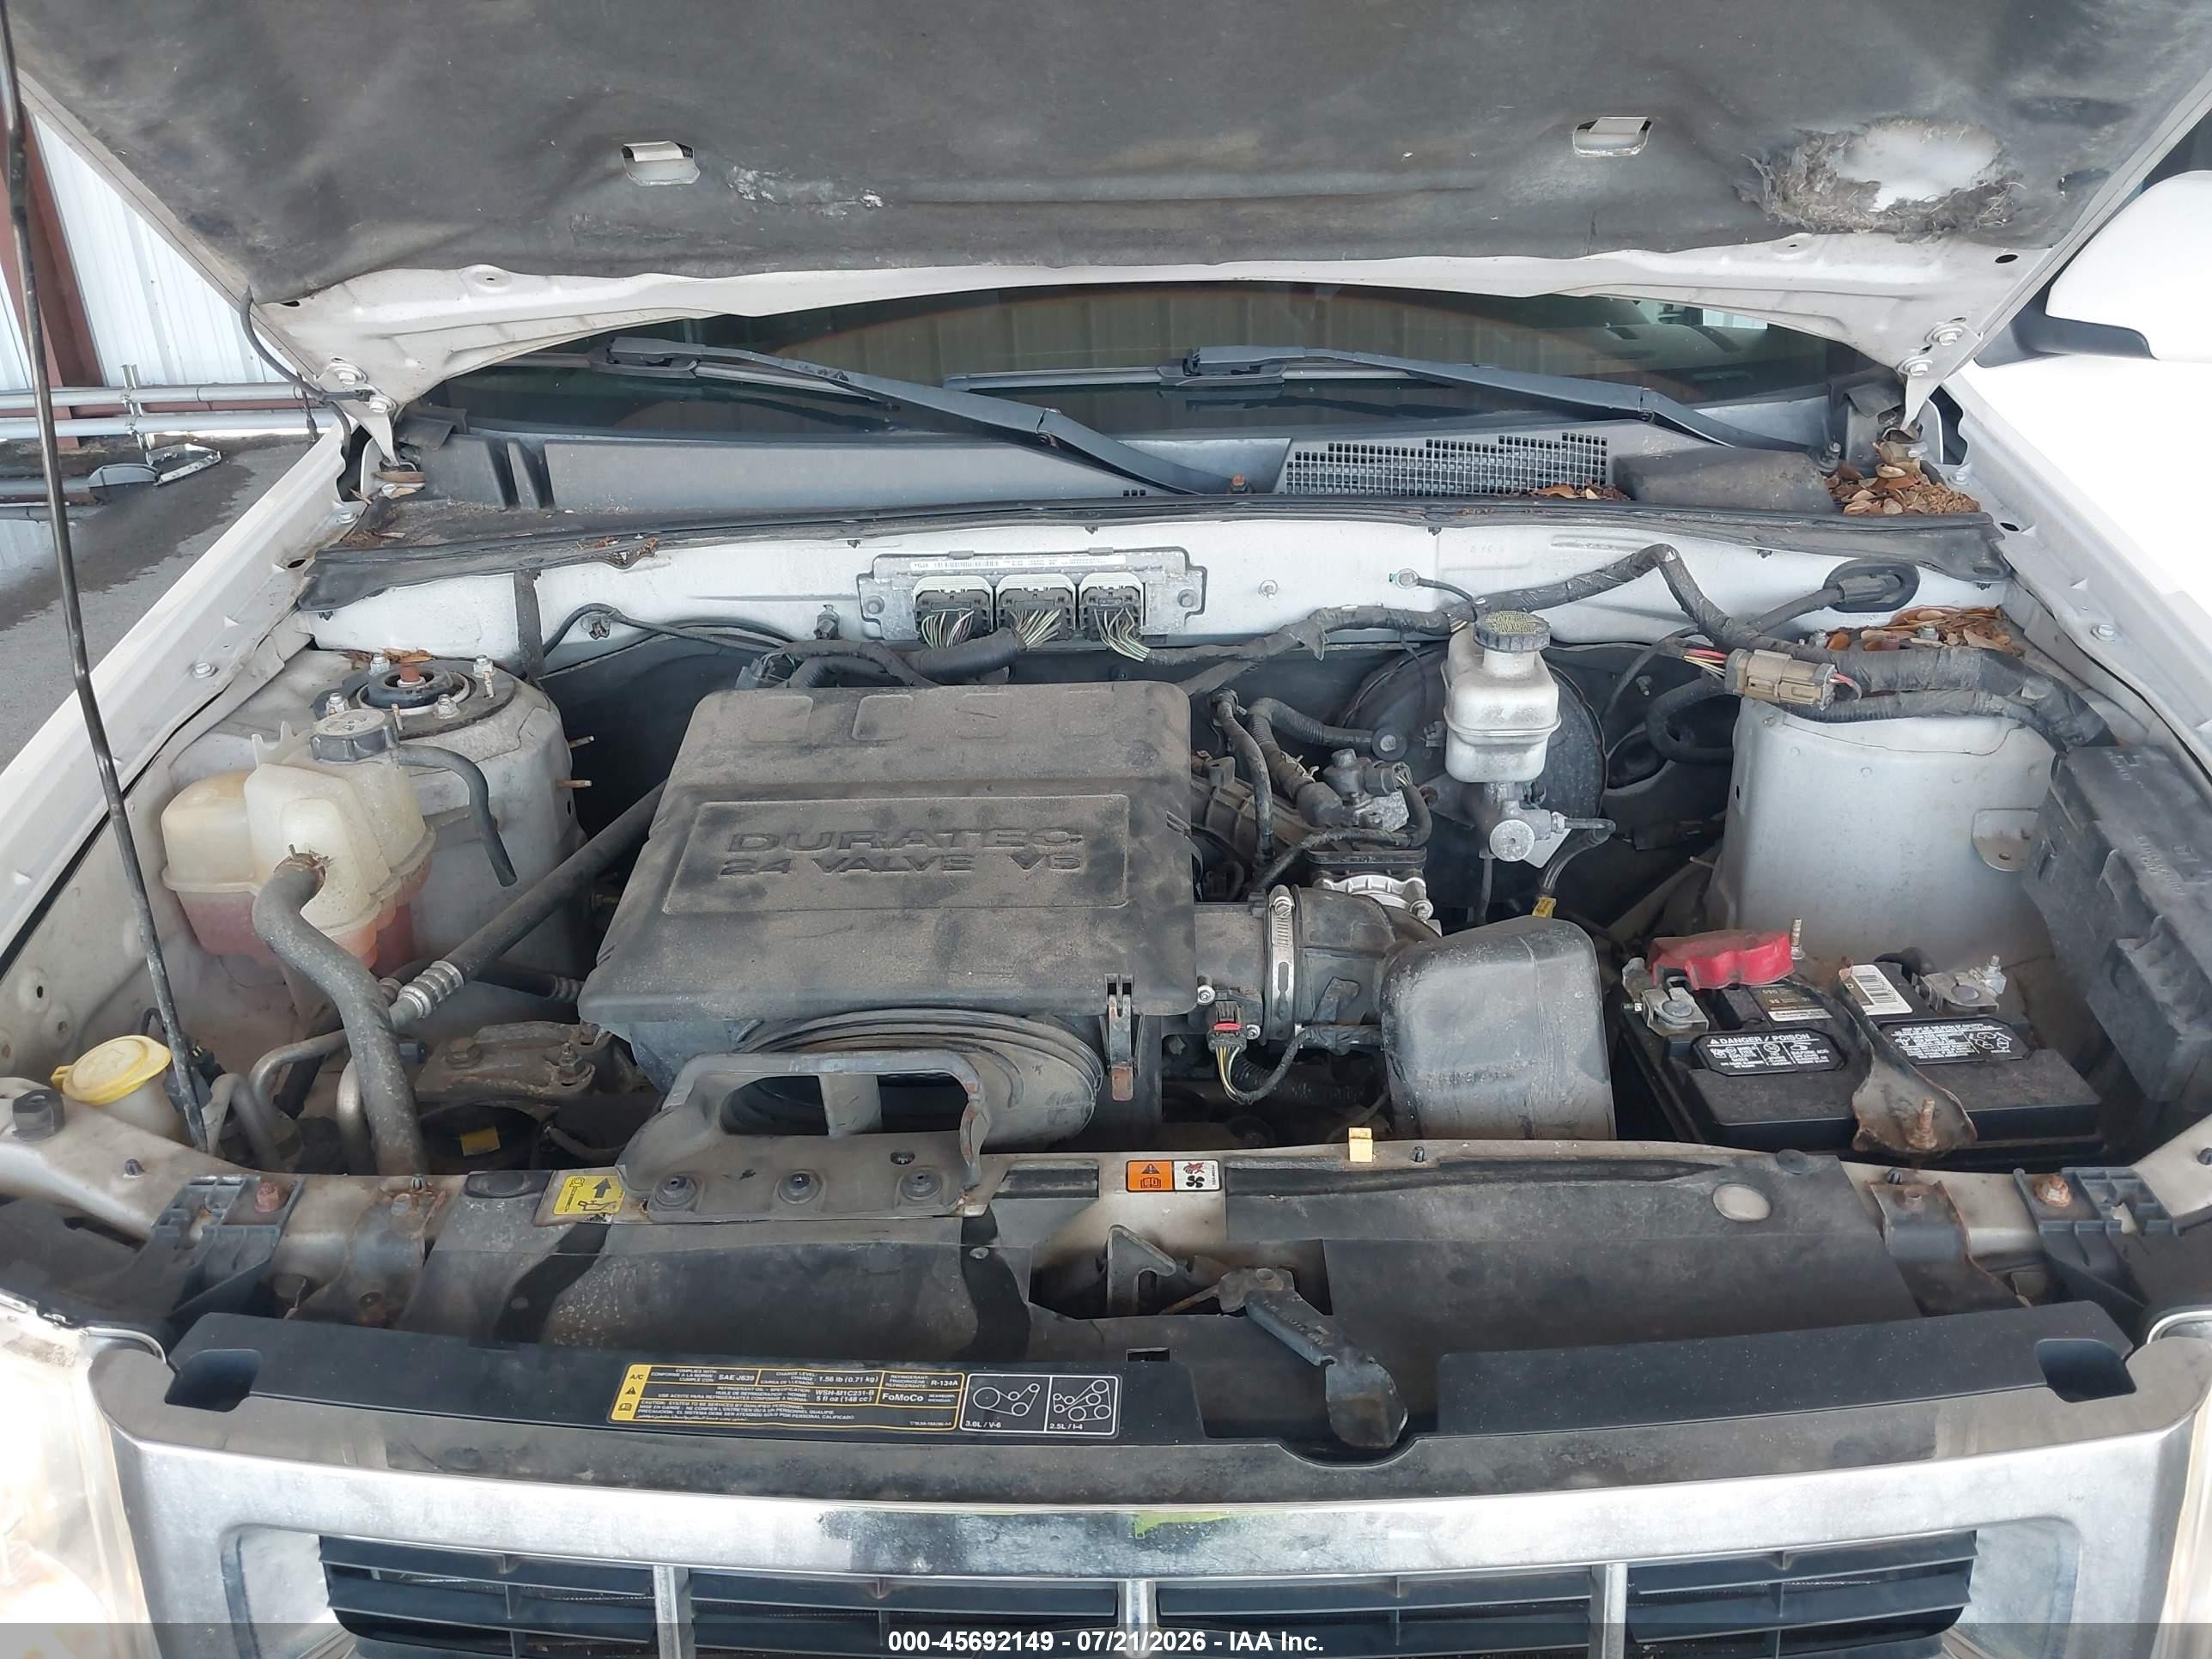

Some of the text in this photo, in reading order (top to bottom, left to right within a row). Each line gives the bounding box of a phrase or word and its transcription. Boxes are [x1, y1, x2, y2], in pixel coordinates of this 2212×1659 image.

[720, 852, 1081, 876] 24 VALVE V6
[1719, 1036, 1761, 1045] DANGER
[1771, 1033, 1811, 1042] POISON
[882, 1392, 924, 1401] FoMoCo
